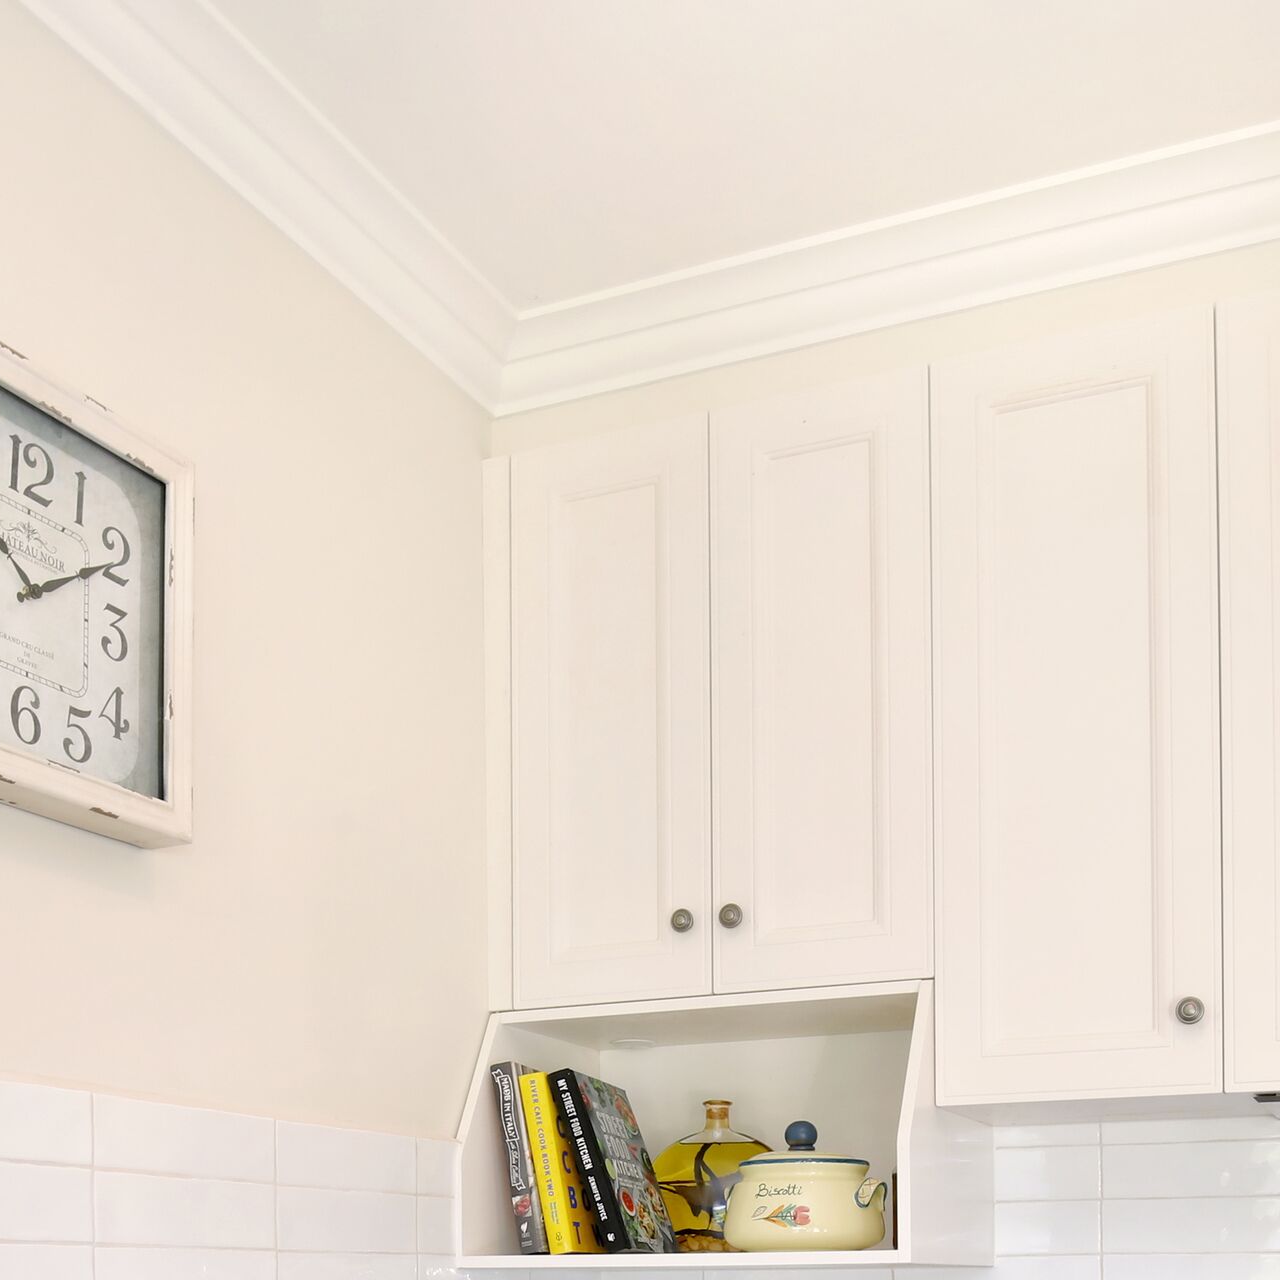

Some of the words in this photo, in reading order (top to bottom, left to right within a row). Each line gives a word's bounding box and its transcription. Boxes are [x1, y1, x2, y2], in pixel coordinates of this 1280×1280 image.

[8, 433, 53, 509] 12
[74, 471, 87, 526] 1
[40, 551, 65, 573] NOIR
[102, 526, 131, 587] 2
[102, 603, 129, 662] 3
[10, 685, 41, 745] 6
[99, 685, 130, 741] 4
[62, 703, 93, 764] 5
[529, 1079, 538, 1103] RIVER
[557, 1078, 569, 1091] MY
[561, 1092, 577, 1118] STREET
[505, 1112, 516, 1139] ITALY
[569, 1117, 583, 1137] FOOD
[537, 1128, 548, 1152] COOK
[541, 1153, 551, 1177] BOOK
[575, 1137, 594, 1171] KITCHEN
[544, 1178, 555, 1198] TWO
[587, 1175, 602, 1203] JENNIFER
[596, 1201, 609, 1222] JOYCE
[755, 1183, 803, 1199] Biscotti
